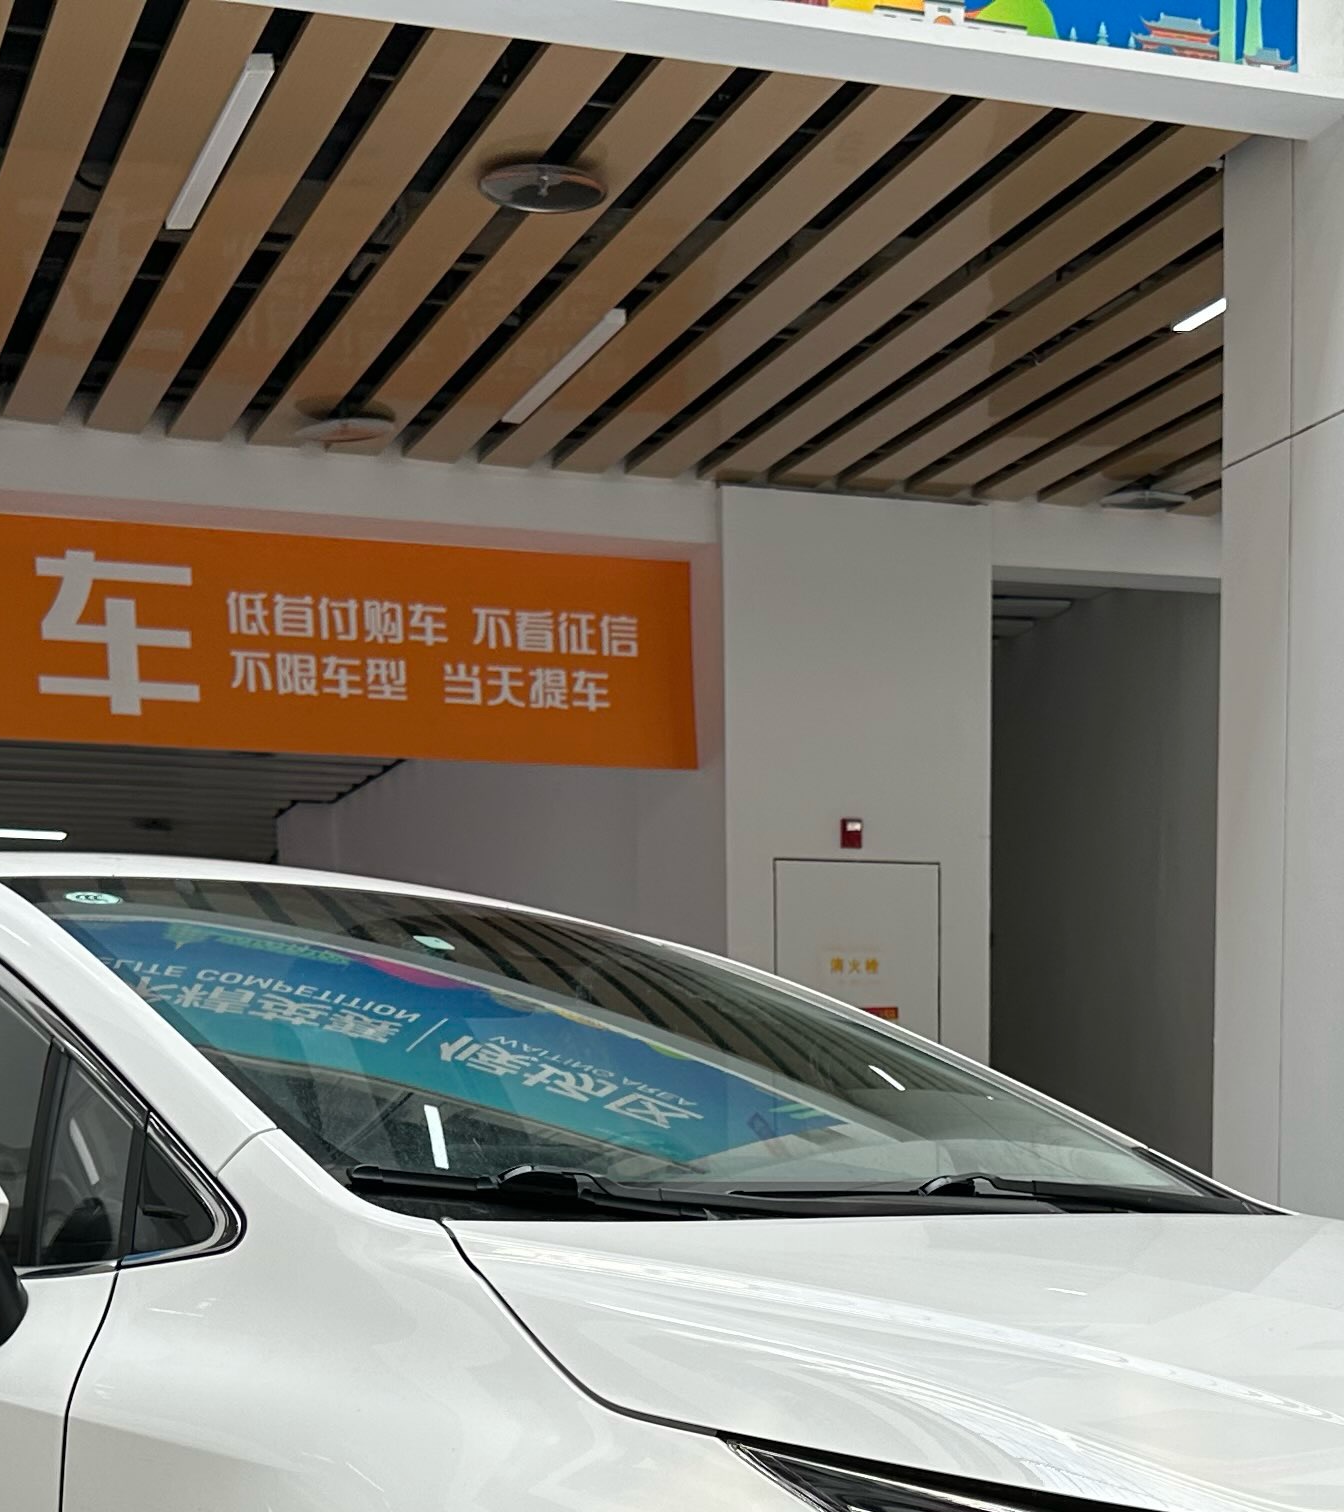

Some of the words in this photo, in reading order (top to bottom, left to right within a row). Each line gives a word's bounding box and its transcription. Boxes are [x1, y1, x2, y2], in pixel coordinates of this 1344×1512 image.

[226, 590, 449, 646] 低首付购车
[472, 607, 640, 658] 不看征信
[230, 650, 408, 701] 不限车型
[443, 662, 611, 712] 当天提车
